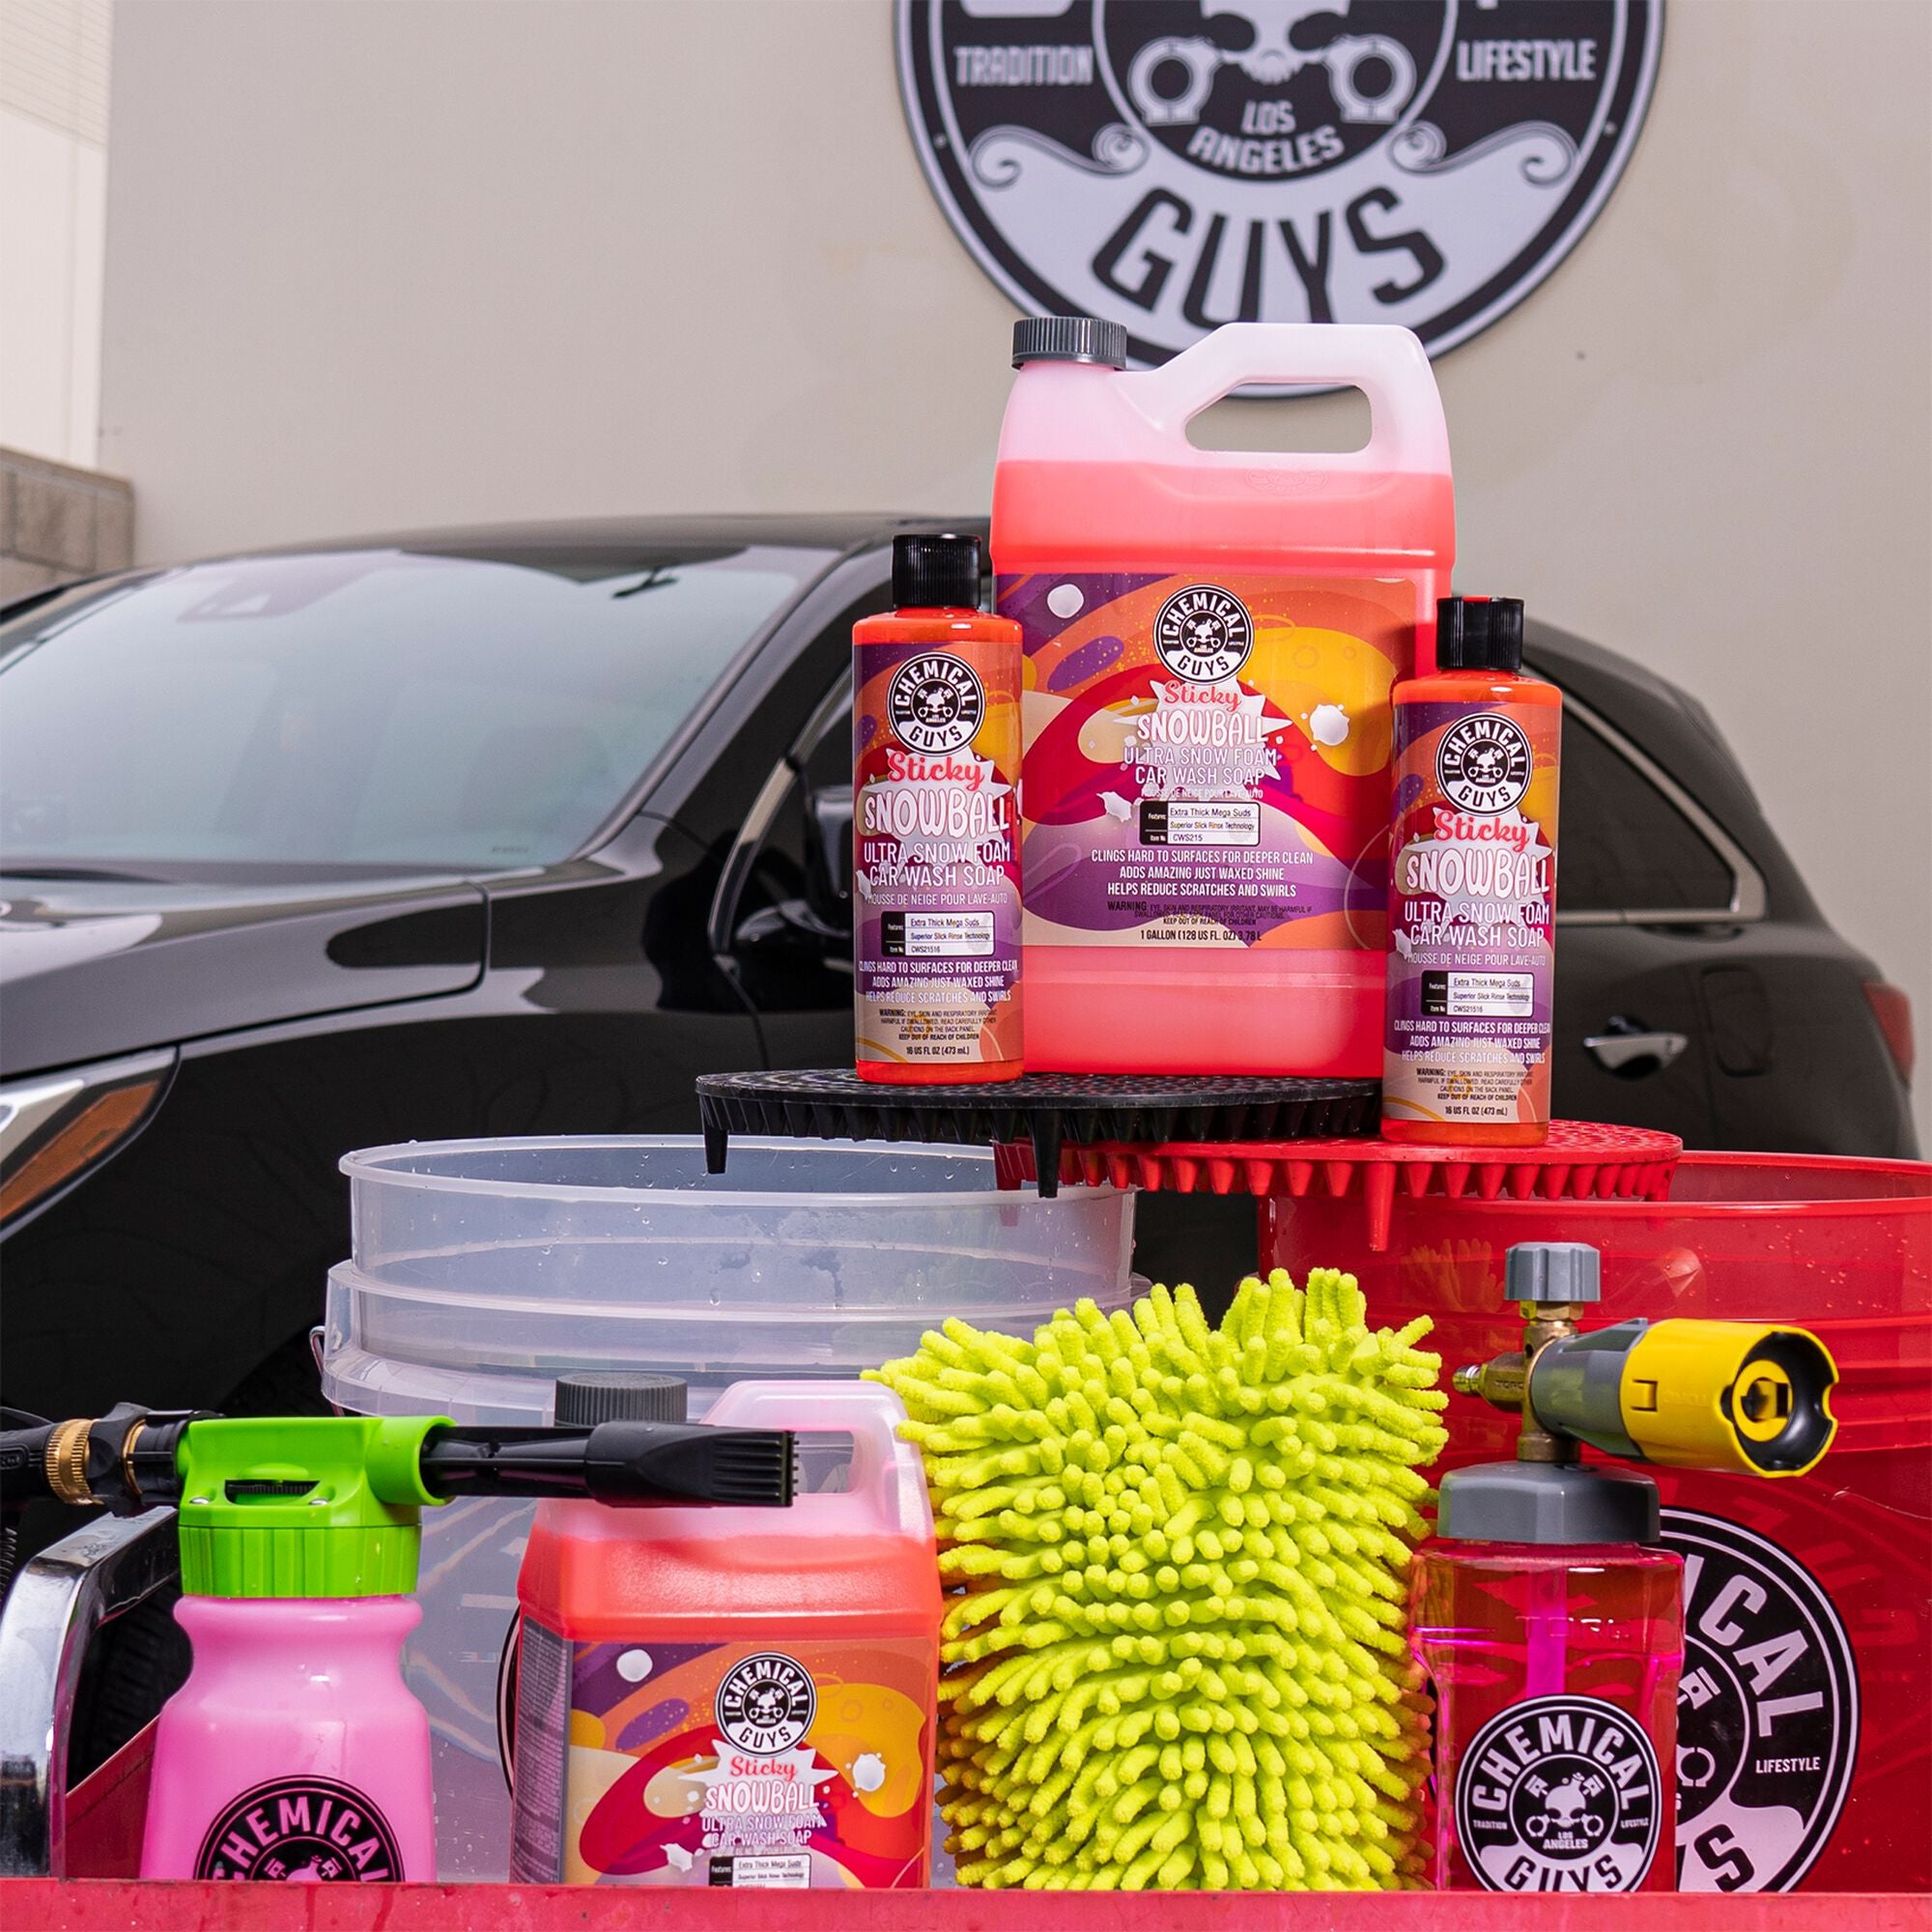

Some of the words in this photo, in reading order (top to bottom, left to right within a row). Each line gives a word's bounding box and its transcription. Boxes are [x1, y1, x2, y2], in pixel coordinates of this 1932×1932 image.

[955, 45, 1094, 87] TRADITION
[1456, 39, 1596, 81] LIFESTYLE
[1242, 99, 1295, 133] LOS
[1188, 127, 1345, 176] ANGELES
[1092, 186, 1446, 326] GUYS
[1162, 591, 1245, 639] CHEMICAL
[1178, 655, 1229, 676] GUYS
[895, 660, 978, 707] CHEMICAL
[1164, 680, 1242, 712] Sticky
[909, 725, 963, 747] GUYS
[1137, 710, 1268, 748] SNOWBALL
[1444, 721, 1526, 767] CHEMICAL
[1124, 747, 1173, 765] ULTRA
[1180, 748, 1230, 765] SNOW
[1235, 749, 1277, 766] FOAM
[888, 751, 985, 792] Sticky
[1135, 767, 1167, 784] CAR
[1173, 767, 1218, 784] WASH
[1222, 767, 1264, 785] SOAP
[1458, 785, 1511, 807] GUYS
[865, 788, 1010, 838] SNOWBALL
[1170, 808, 1188, 816] Extra
[1191, 808, 1209, 816] Thick
[1211, 809, 1231, 818] Mega
[1233, 809, 1251, 817] Suds
[1434, 810, 1530, 853] Sticky
[864, 842, 908, 863] ULTRA
[914, 843, 969, 864] SNOW
[974, 842, 1011, 862] FOAM
[1092, 850, 1126, 862] CLINGS
[1128, 850, 1155, 862] HARD
[1157, 851, 1169, 863] TO
[1171, 851, 1220, 863] SURFACES
[1222, 851, 1241, 863] FOR
[1244, 851, 1280, 864] DEEPER
[1282, 852, 1314, 865] CLEAN
[869, 867, 900, 886] CAR
[905, 867, 957, 887] WASH
[963, 866, 1004, 886] SOAP
[1120, 867, 1146, 878] ADDS
[1147, 867, 1192, 879] AMAZING
[1193, 867, 1216, 879] JUST
[1219, 867, 1254, 880] WAXED
[1256, 868, 1284, 881] SHINE
[1406, 848, 1550, 899] SNOWBALL
[897, 894, 908, 905] DE
[911, 894, 938, 905] NEIGE
[940, 894, 966, 905] POUR
[1108, 883, 1138, 895] HELPS
[1140, 883, 1178, 895] REDUCE
[1180, 883, 1236, 896] SCRATCHES
[1238, 884, 1258, 896] AND
[1260, 884, 1296, 897] SWIRLS
[911, 918, 925, 927] Extra
[928, 918, 944, 927] Thick
[1405, 901, 1453, 922] ULTRA
[1459, 902, 1513, 923] SNOW
[1518, 904, 1550, 925] FOAM
[1141, 930, 1144, 939] 1
[1146, 930, 1177, 939] GALLON
[1178, 930, 1196, 940] (128
[1198, 931, 1208, 940] US
[1210, 931, 1221, 940] FL.
[1223, 931, 1236, 940] OZ)
[1411, 925, 1442, 946] CAR
[1449, 926, 1501, 947] WASH
[1507, 927, 1545, 948] SOAP
[877, 961, 895, 973] HARD
[898, 962, 908, 973] TO
[910, 962, 954, 974] SURFACES
[956, 962, 972, 973] FOR
[974, 961, 1001, 973] DEEPER
[1440, 953, 1451, 965] DE
[1455, 953, 1482, 965] NEIGE
[1485, 954, 1508, 966] POUR
[872, 978, 890, 988] ADDS
[892, 978, 930, 988] AMAZING
[931, 977, 952, 988] JUST
[953, 977, 984, 988] WAXED
[985, 976, 1004, 987] SHINE
[1454, 978, 1470, 987] Extra
[1472, 979, 1488, 987] Thick
[1490, 979, 1506, 989] Mega
[918, 992, 968, 1003] SCRATCHES
[1415, 1020, 1436, 1032] HARD
[1439, 1021, 1449, 1032] TO
[1451, 1021, 1495, 1033] SURFACES
[1497, 1022, 1513, 1034] FOR
[1514, 1022, 1538, 1034] DEEPER
[1410, 1036, 1430, 1047] ADDS
[1431, 1037, 1470, 1048] AMAZING
[1493, 1037, 1522, 1049] WAXED
[1424, 1052, 1456, 1063] REDUCE
[1459, 1052, 1509, 1064] SCRATCHES
[1453, 1107, 1462, 1115] US
[724, 1661, 809, 1708] CHEMICAL
[739, 1726, 792, 1748] GUYS
[729, 1755, 798, 1782] Sticky
[1472, 1714, 1649, 1811] CHEMICAL
[1756, 1757, 1820, 1774] LIFESTYLE
[705, 1780, 820, 1814] SNOWBALL
[702, 1817, 743, 1832] ULTRA
[747, 1815, 784, 1830] SNOW
[1473, 1819, 1508, 1830] TRADITION
[711, 1833, 737, 1848] CAR
[740, 1832, 777, 1847] WASH
[780, 1831, 812, 1845] SOAP
[1543, 1838, 1589, 1850] ANGELES
[1558, 1832, 1573, 1840] LOS
[1504, 1854, 1622, 1892] GUYS
